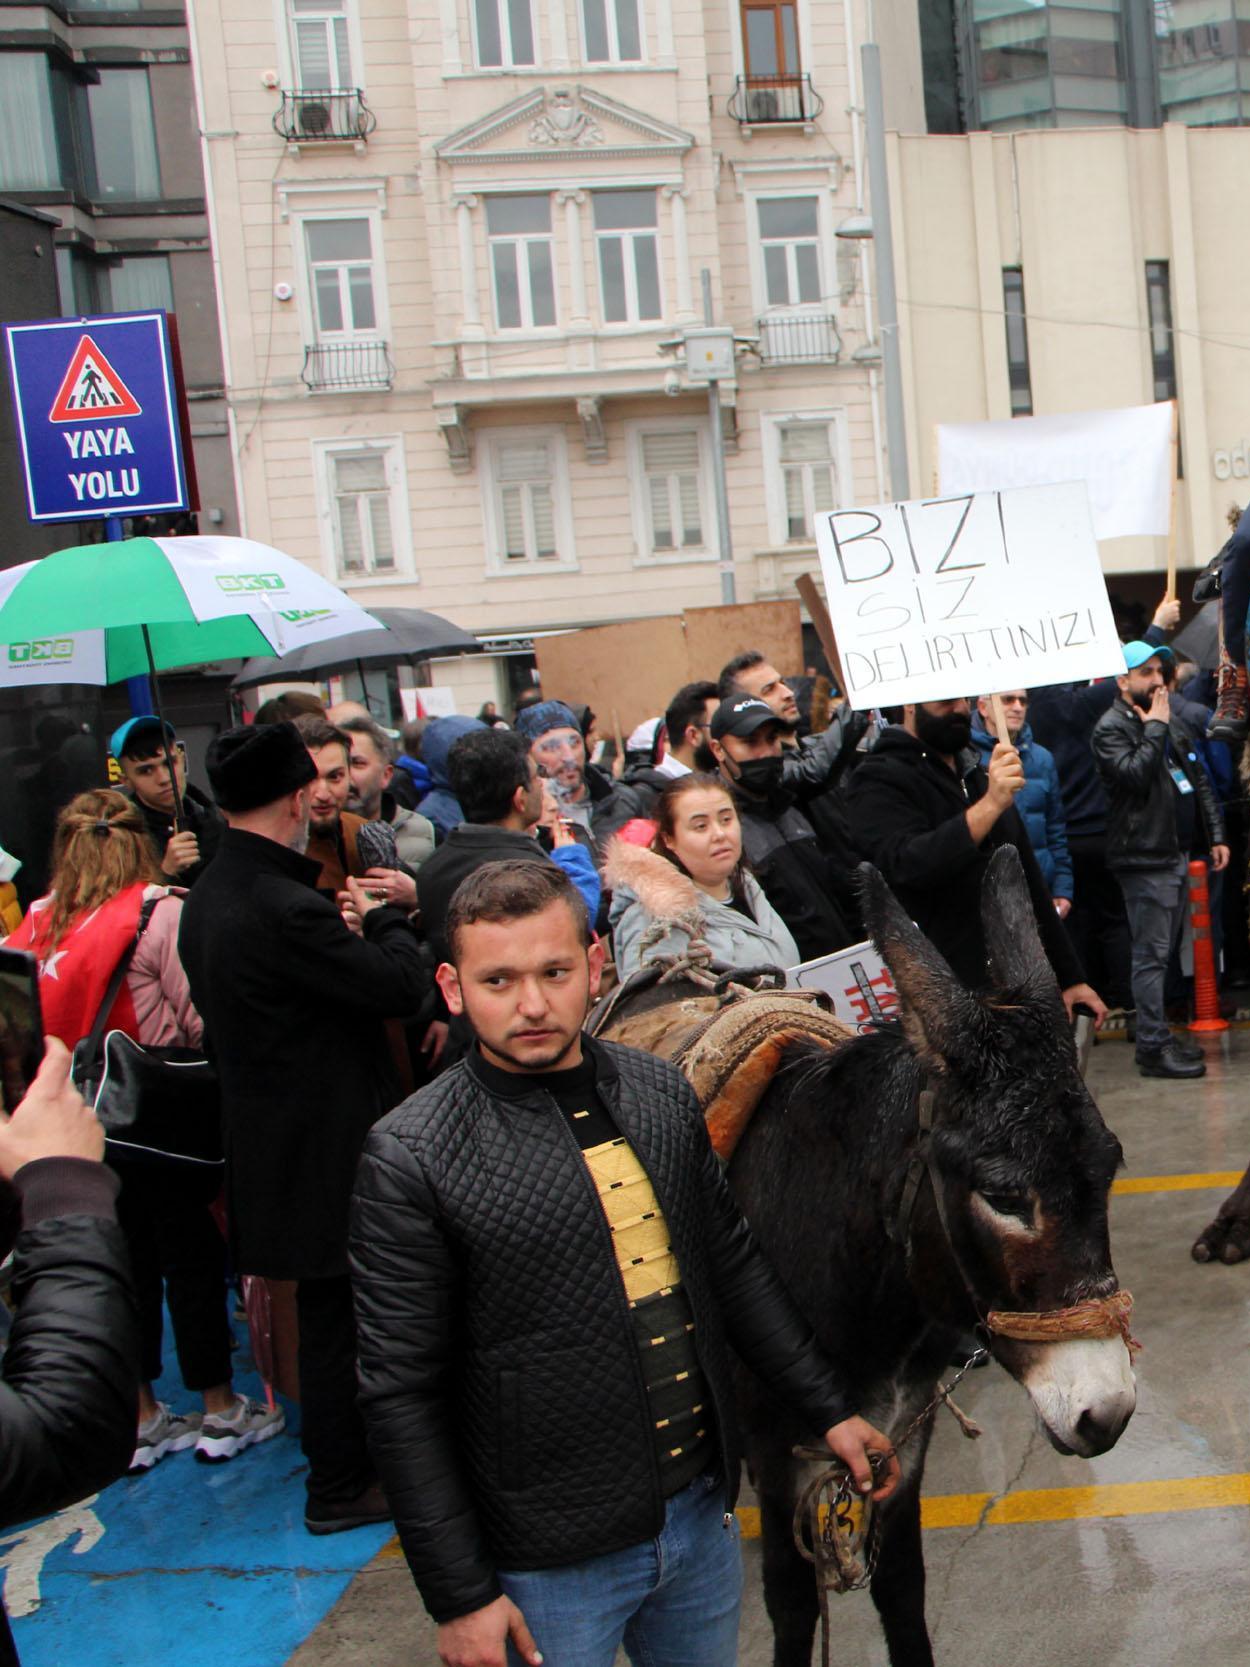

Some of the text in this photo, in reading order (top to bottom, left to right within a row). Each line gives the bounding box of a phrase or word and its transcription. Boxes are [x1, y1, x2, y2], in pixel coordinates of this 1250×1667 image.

[63, 427, 135, 459] YAYA
[67, 468, 140, 501] YOLU
[215, 573, 286, 592] BKT
